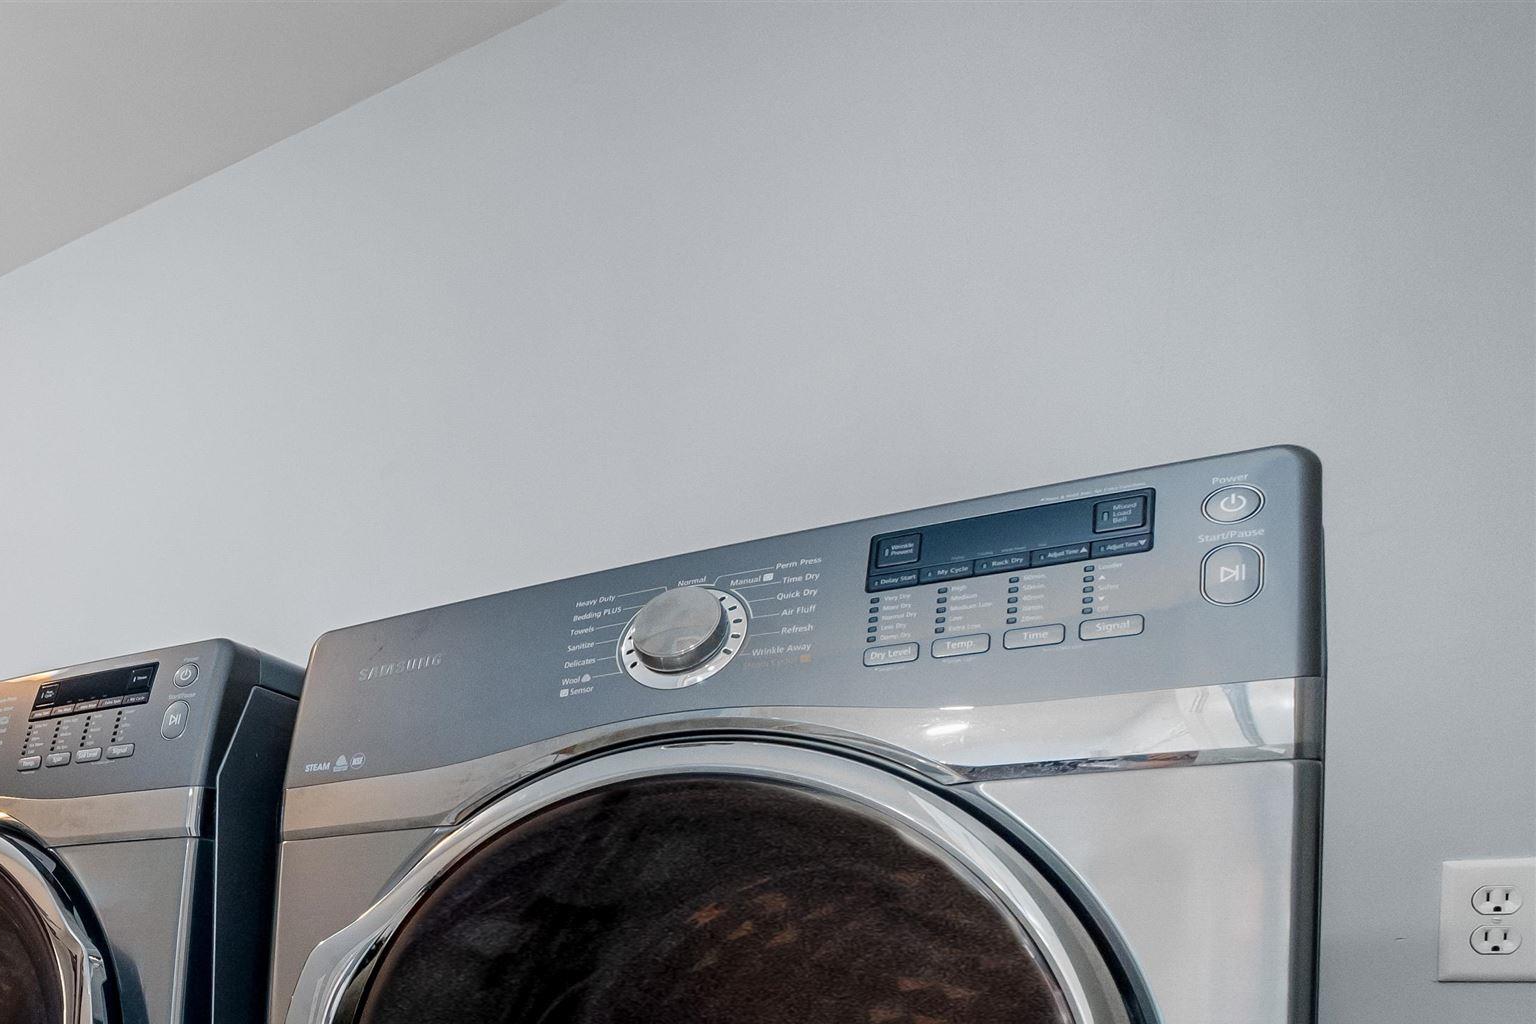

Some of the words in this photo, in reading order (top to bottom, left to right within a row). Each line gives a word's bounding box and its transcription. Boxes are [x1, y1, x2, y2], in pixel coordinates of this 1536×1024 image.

[1211, 473, 1249, 485] Power
[1198, 528, 1265, 543] Start/Pause
[775, 560, 801, 571] Perm
[801, 556, 823, 568] Press
[1010, 555, 1024, 565] Dry
[782, 575, 802, 585] Time
[802, 572, 821, 583] Dry
[936, 569, 949, 577] My
[677, 575, 707, 587] Normal
[730, 575, 762, 587] Manual
[880, 576, 899, 586] Delay
[776, 590, 799, 602] Quick
[800, 587, 819, 599] Dry
[575, 597, 599, 609] Heavy
[599, 594, 617, 605] Duty
[573, 610, 602, 623] Bedding
[603, 605, 623, 618] PLUS
[781, 606, 793, 617] Air
[795, 604, 817, 616] Fluff
[570, 624, 595, 636] Towels
[780, 623, 814, 635] Refresh
[1095, 620, 1131, 633] Signal
[1022, 630, 1049, 640] Time
[567, 640, 595, 652] Sanitize
[751, 644, 785, 657] Wrinkle
[786, 642, 812, 655] Away
[945, 639, 977, 652] Temp.
[869, 650, 886, 661] Dry
[887, 647, 912, 659] Level
[358, 653, 443, 682] SAMSUNG
[563, 657, 597, 669] Delicates
[561, 675, 581, 686] Wool
[569, 685, 595, 697] Sensor
[304, 762, 331, 773] STEAM
